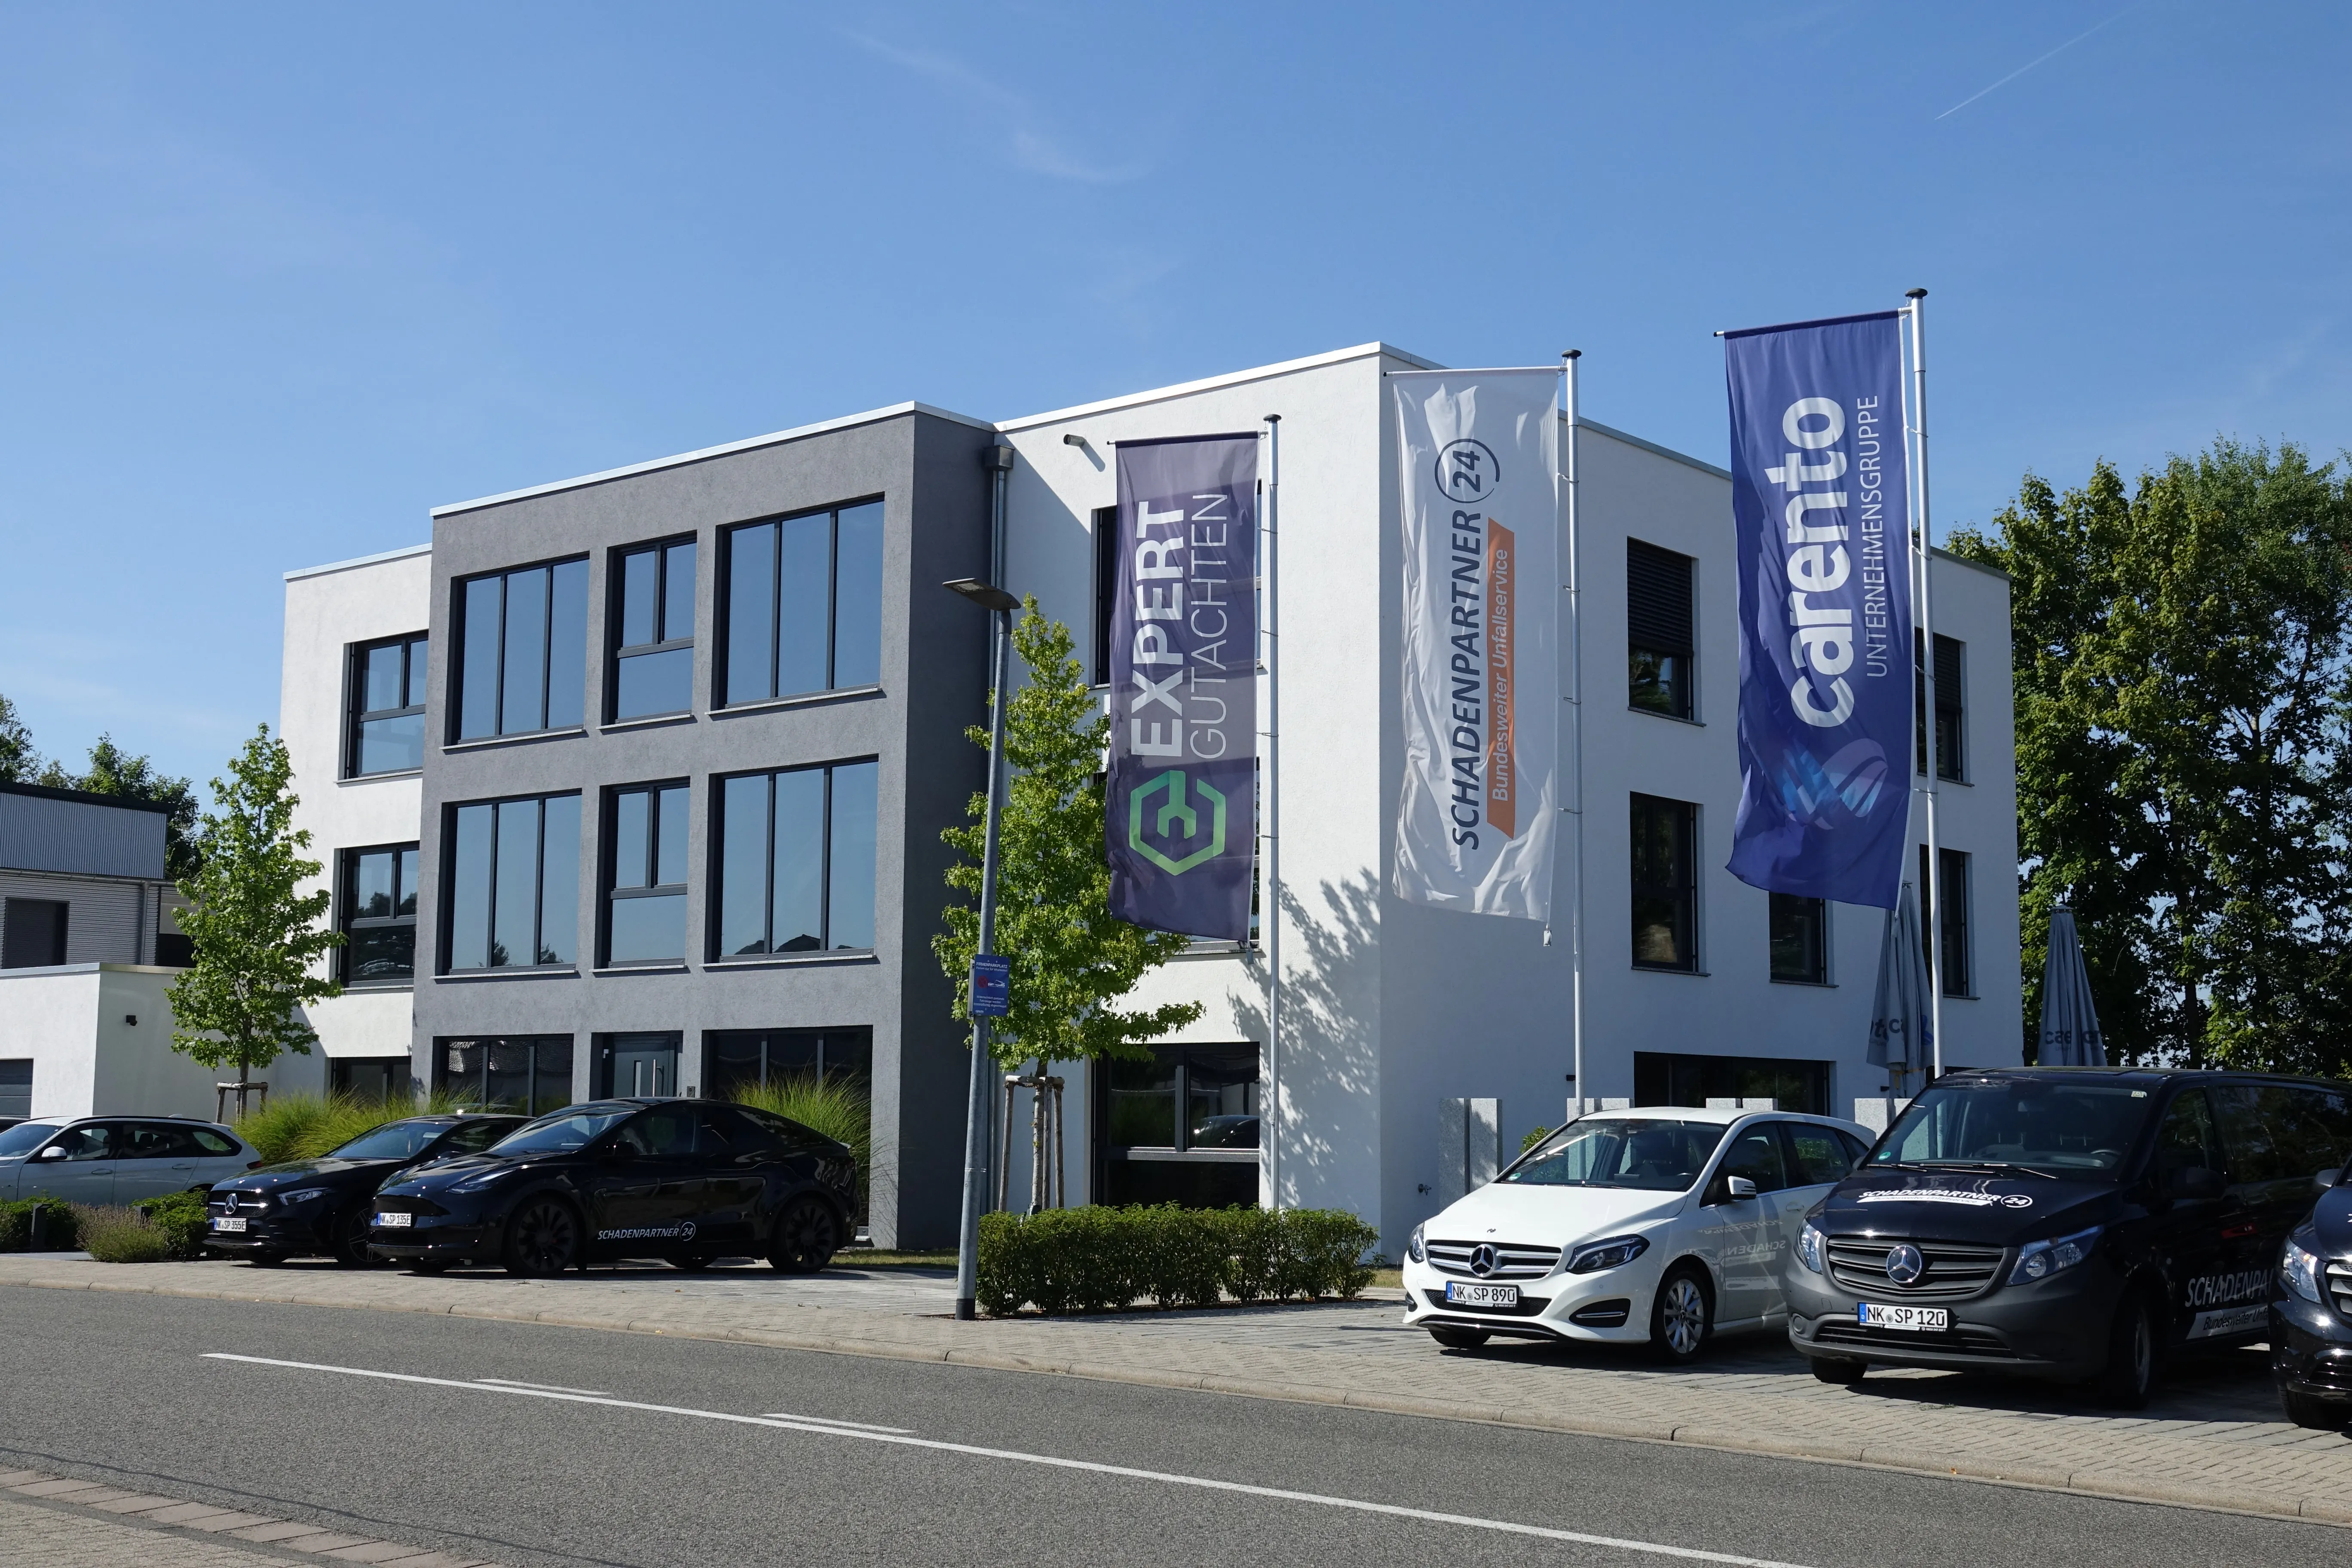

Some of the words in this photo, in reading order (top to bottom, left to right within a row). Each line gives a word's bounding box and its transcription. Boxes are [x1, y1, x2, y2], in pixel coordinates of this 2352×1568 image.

[1452, 450, 1480, 493] 24
[1857, 395, 1887, 678] UNTERNEHMENSGRUPPE
[1764, 397, 1855, 727] carento
[1131, 501, 1184, 756] EXPERT
[1190, 494, 1228, 759] GUTACHTEN
[1491, 549, 1508, 668] Unfallservice
[1451, 510, 1480, 850] SCHADENPARTNER
[1492, 673, 1508, 802] Bundesweiter
[1859, 1189, 2002, 1202] SCHADENPARTNER
[224, 1220, 230, 1229] SP
[231, 1221, 246, 1230] 355E
[389, 1215, 395, 1224] SP
[397, 1215, 410, 1225] 135E
[597, 1228, 679, 1240] SCHADENPARTNER
[682, 1227, 693, 1236] 24
[1453, 1285, 1466, 1299] NK
[1474, 1288, 1488, 1301] SP
[1491, 1288, 1515, 1302] 890
[1867, 1306, 1885, 1322] NK
[1895, 1308, 1913, 1323] SP
[1917, 1310, 1945, 1326] 120
[2203, 1313, 2252, 1331] Bundesweiter
